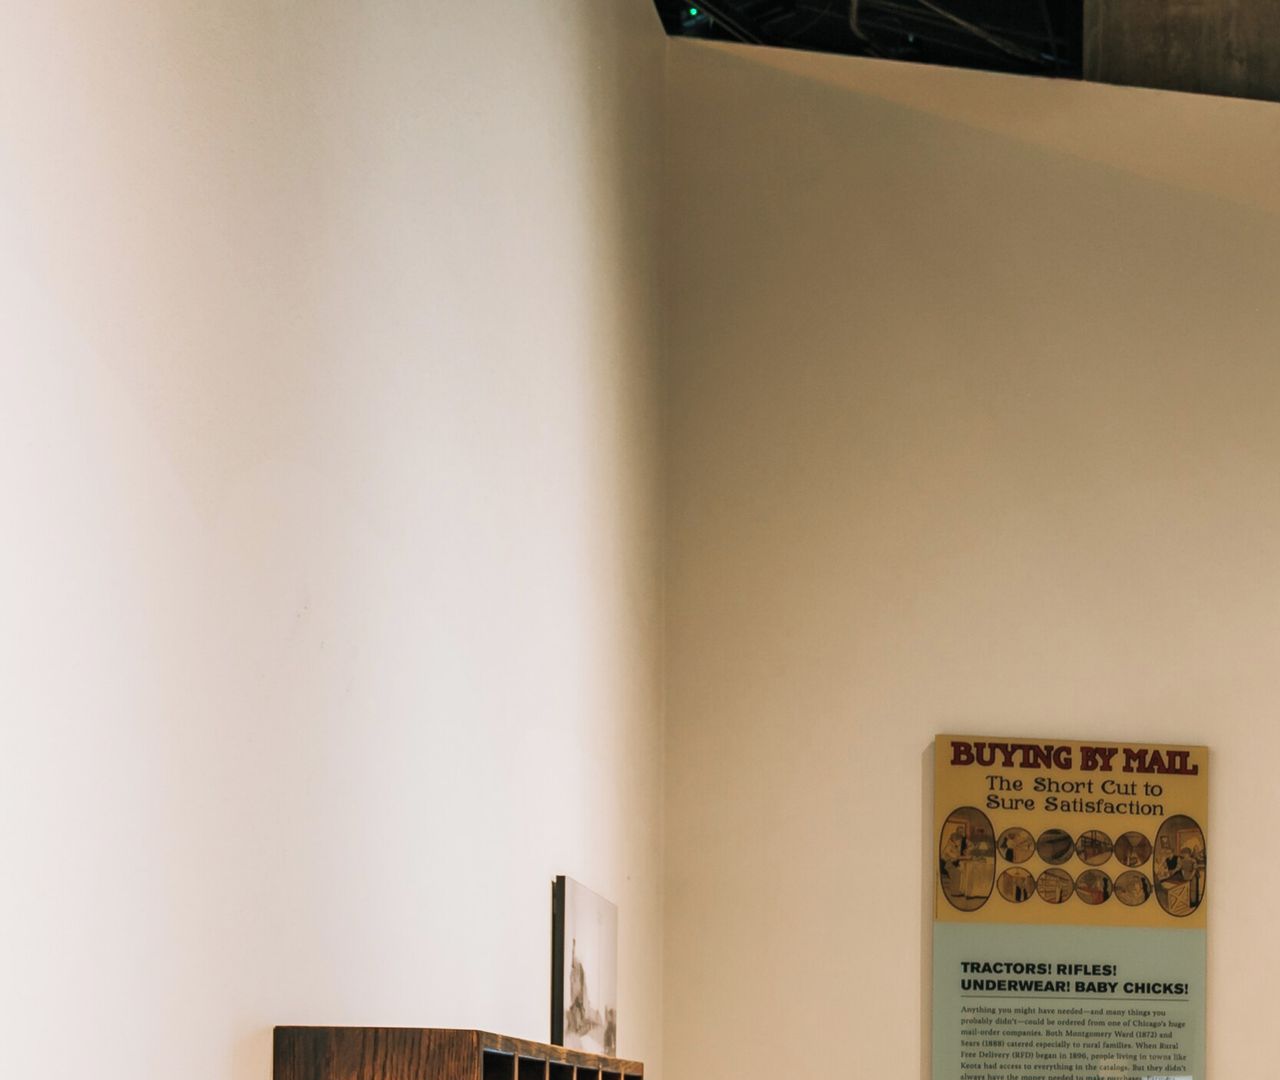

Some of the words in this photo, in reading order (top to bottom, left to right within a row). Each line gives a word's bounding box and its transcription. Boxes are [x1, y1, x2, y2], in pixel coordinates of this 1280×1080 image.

[950, 741, 1072, 770] BUYING
[1080, 746, 1118, 772] BY
[1123, 747, 1198, 776] MAIL
[986, 775, 1023, 791] The
[1033, 777, 1094, 794] Short
[1101, 779, 1137, 795] Cut
[1143, 781, 1163, 797] to
[986, 794, 1035, 811] Sure
[1044, 796, 1164, 816] Satisfaction
[961, 962, 1052, 975] TRACTORS!
[1056, 964, 1117, 976] RIFLES!
[961, 979, 1070, 993] UNDERWEAR!
[1075, 981, 1119, 994] BABY
[1123, 982, 1189, 995] CHICKS!
[961, 1006, 996, 1015] Anything
[998, 1008, 1012, 1016] you
[1014, 1007, 1036, 1016] might
[1038, 1007, 1055, 1015] have
[1106, 1009, 1126, 1017] many
[1127, 1008, 1150, 1018] things
[1152, 1010, 1166, 1018] you
[961, 1016, 993, 1026] probably
[1057, 1018, 1086, 1026] ordered
[1087, 1018, 1106, 1026] from
[1168, 1019, 1186, 1029] huge
[1045, 1029, 1063, 1037] Both
[1065, 1029, 1112, 1039] Montgomery
[1114, 1030, 1134, 1038] Ward
[961, 1039, 980, 1047] Sears
[1006, 1040, 1033, 1048] catered
[1035, 1040, 1071, 1050] especially
[1082, 1041, 1100, 1049] rural
[1135, 1041, 1157, 1049] When
[1159, 1042, 1179, 1050] Rural
[961, 1050, 977, 1058] Free
[978, 1050, 1010, 1060] Delivery
[1036, 1051, 1057, 1061] began
[1059, 1051, 1067, 1059] in
[1090, 1052, 1114, 1061] people
[1116, 1052, 1138, 1062] living
[1149, 1053, 1171, 1061] towns
[1173, 1053, 1187, 1061] like
[960, 1061, 982, 1069] Keota
[1023, 1062, 1032, 1070] to
[1033, 1062, 1074, 1072] everything
[1075, 1063, 1083, 1071] in
[1085, 1063, 1097, 1071] the
[1146, 1064, 1163, 1073] they
[987, 1073, 1005, 1080] have
[1006, 1073, 1019, 1080] the
